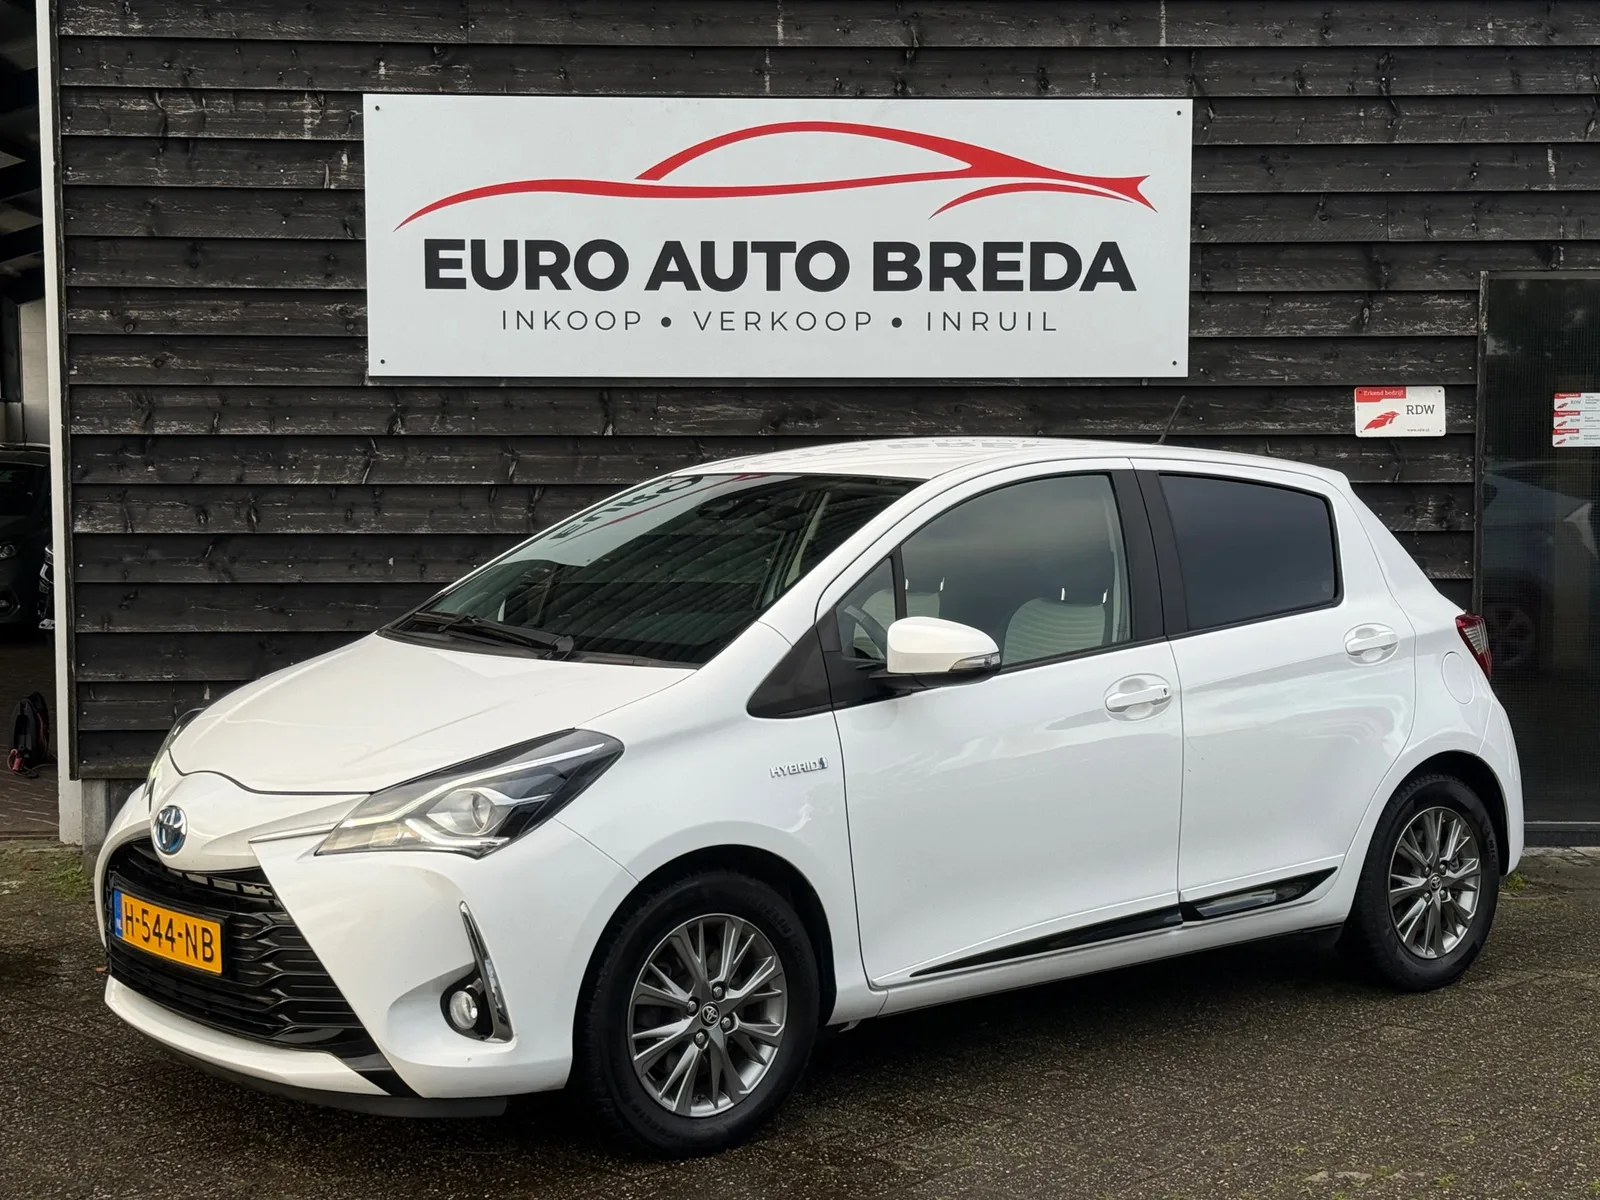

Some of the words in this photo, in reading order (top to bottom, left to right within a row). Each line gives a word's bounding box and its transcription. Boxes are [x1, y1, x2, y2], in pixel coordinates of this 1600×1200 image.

[424, 238, 630, 293] EURO
[644, 240, 850, 293] AUTO
[872, 241, 1137, 293] BREDA
[502, 310, 641, 331] INKOOP
[692, 311, 872, 332] VERKOOP
[927, 311, 1057, 332] INRUIL
[1406, 404, 1436, 415] RDW
[769, 761, 819, 778] HYBRID
[124, 901, 215, 963] H-544-NB
